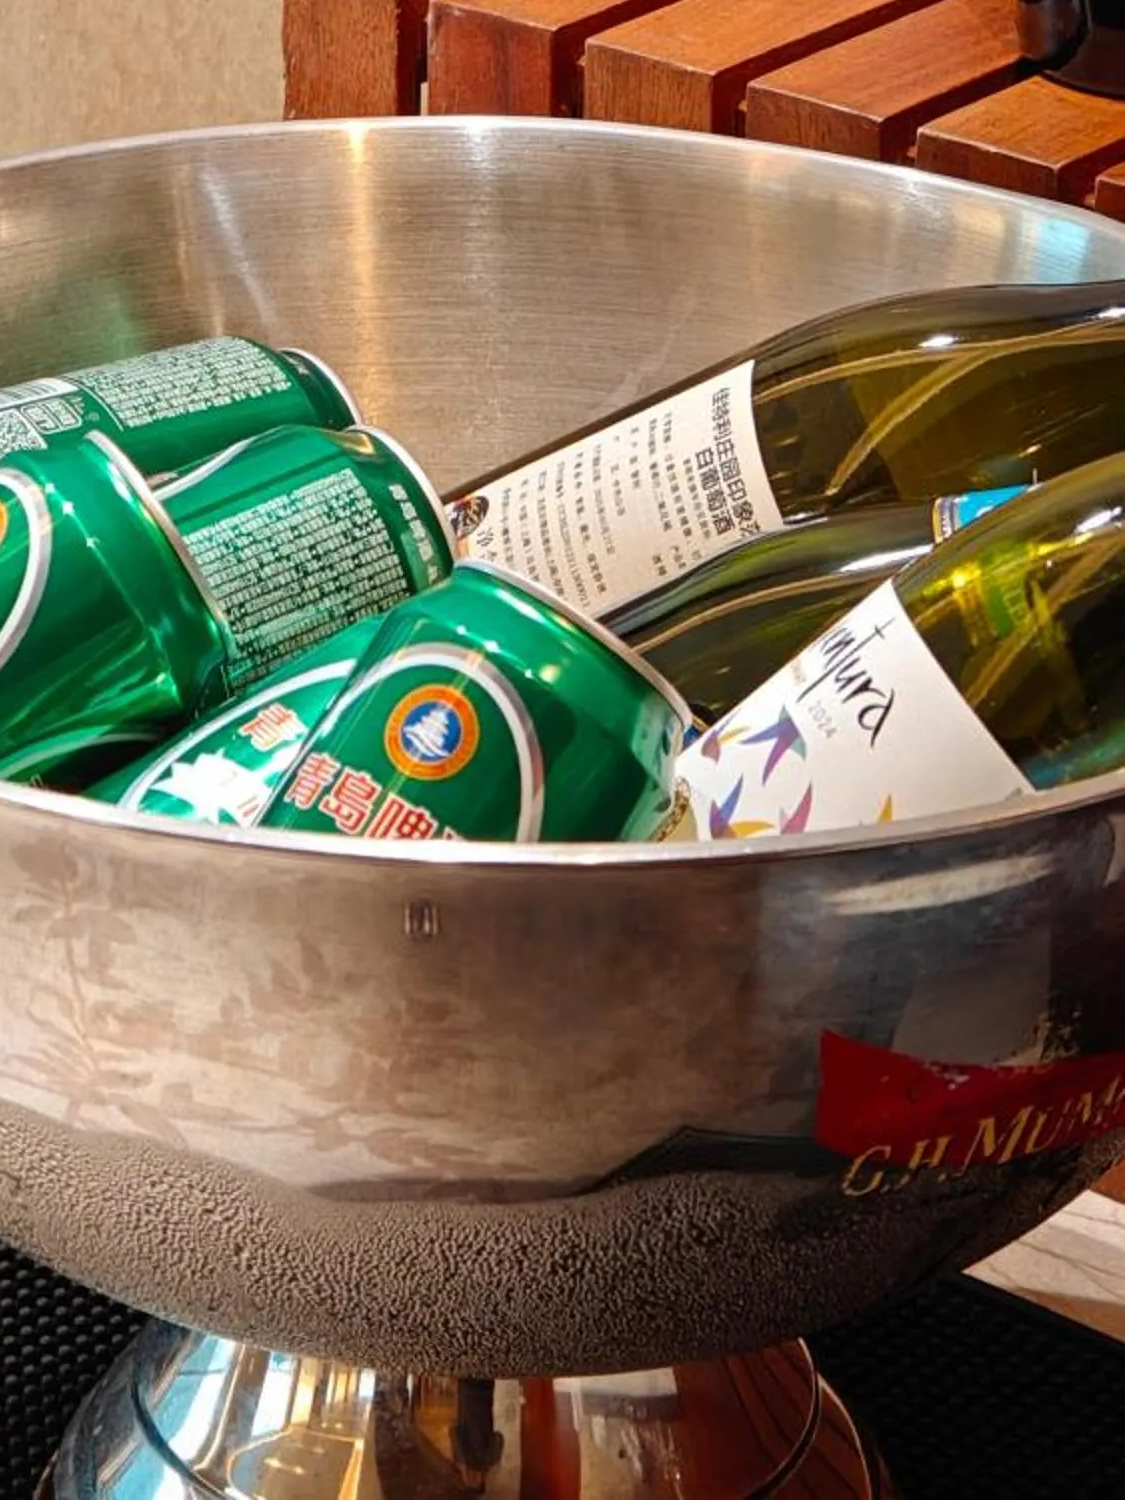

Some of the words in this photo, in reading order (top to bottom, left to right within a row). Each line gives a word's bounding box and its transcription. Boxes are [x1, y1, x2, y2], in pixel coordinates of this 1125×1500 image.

[695, 446, 735, 536] 白葡萄酒
[808, 700, 837, 739] 2024
